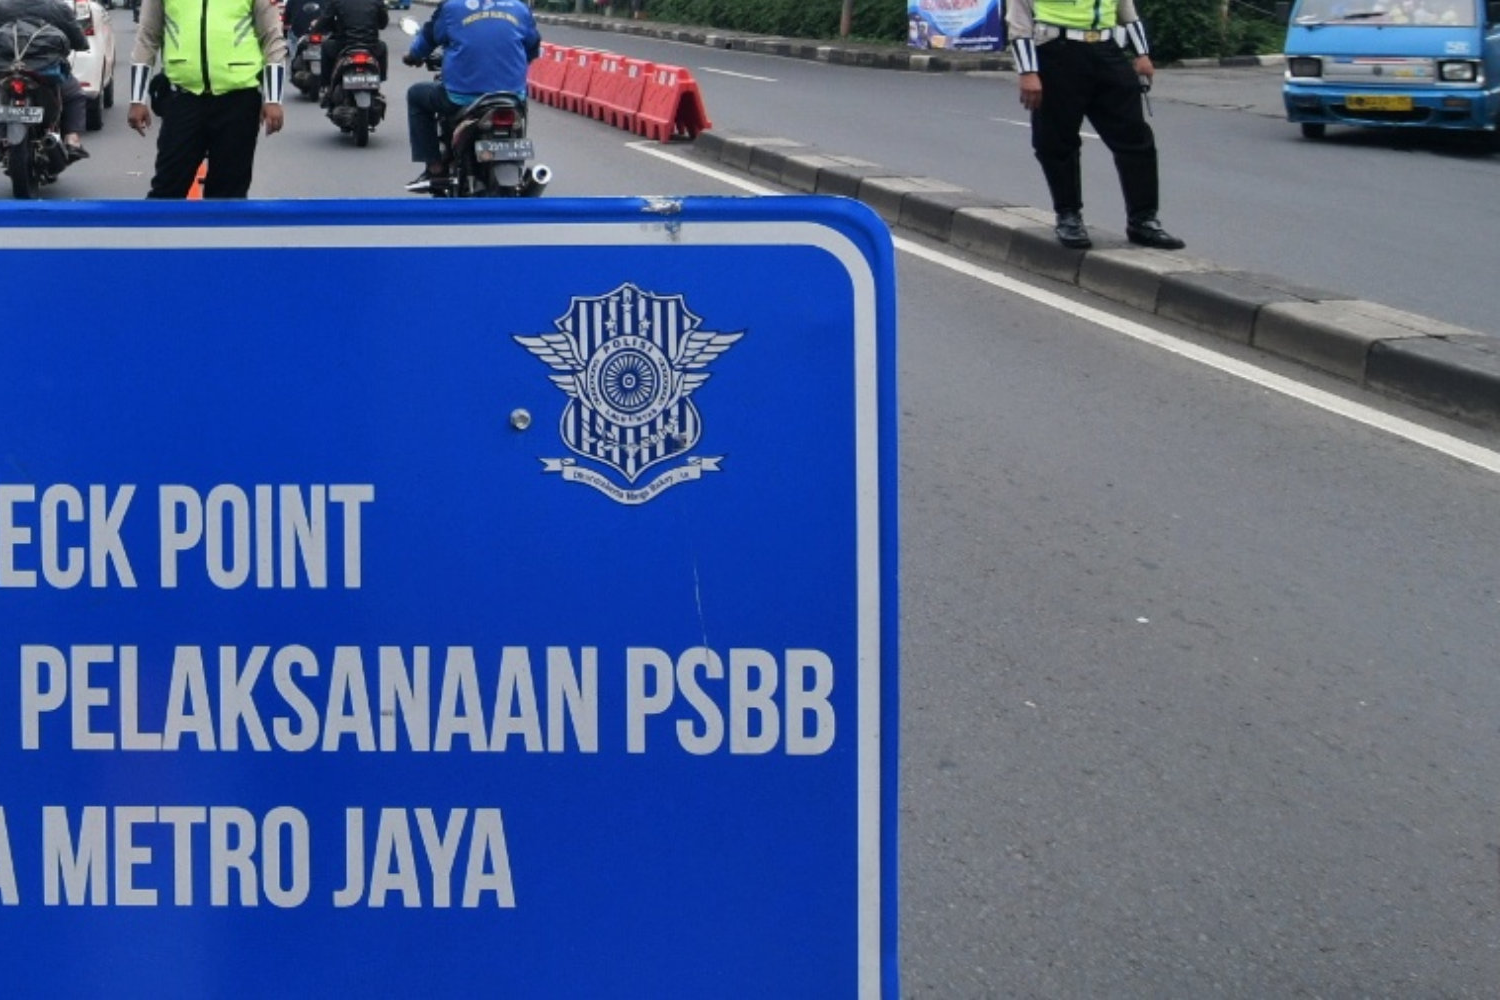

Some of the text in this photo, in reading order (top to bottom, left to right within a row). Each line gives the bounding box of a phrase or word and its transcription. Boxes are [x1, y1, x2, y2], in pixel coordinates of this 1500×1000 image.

[603, 337, 654, 354] POLISI
[159, 484, 375, 590] POINT
[20, 645, 598, 753] PELAKSANAAN
[626, 647, 837, 755] PSBB
[43, 805, 311, 908] METRO
[332, 807, 516, 909] JAYA
